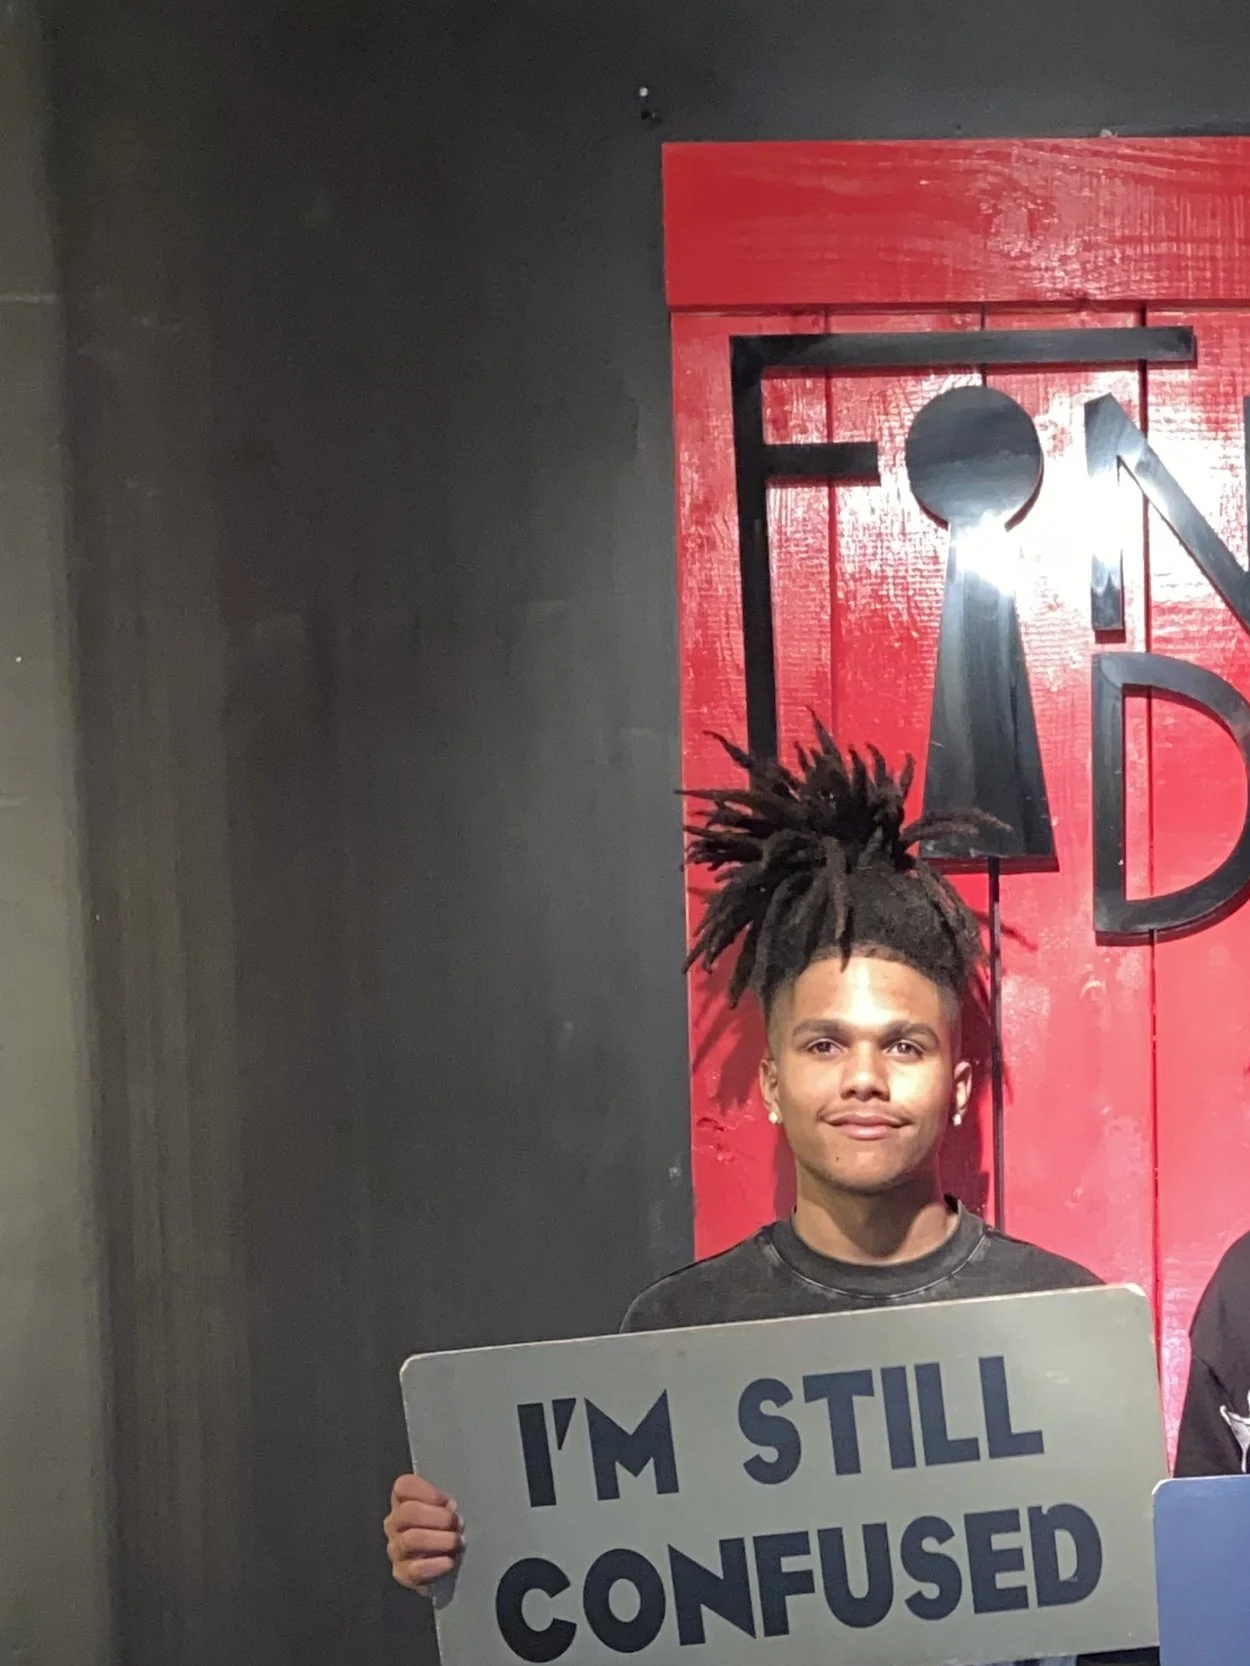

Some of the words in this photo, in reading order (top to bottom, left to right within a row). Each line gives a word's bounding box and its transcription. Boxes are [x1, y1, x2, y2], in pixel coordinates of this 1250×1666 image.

[517, 1388, 680, 1507] I'M
[738, 1356, 1044, 1484] STILL
[495, 1503, 1102, 1662] CONFUSED
